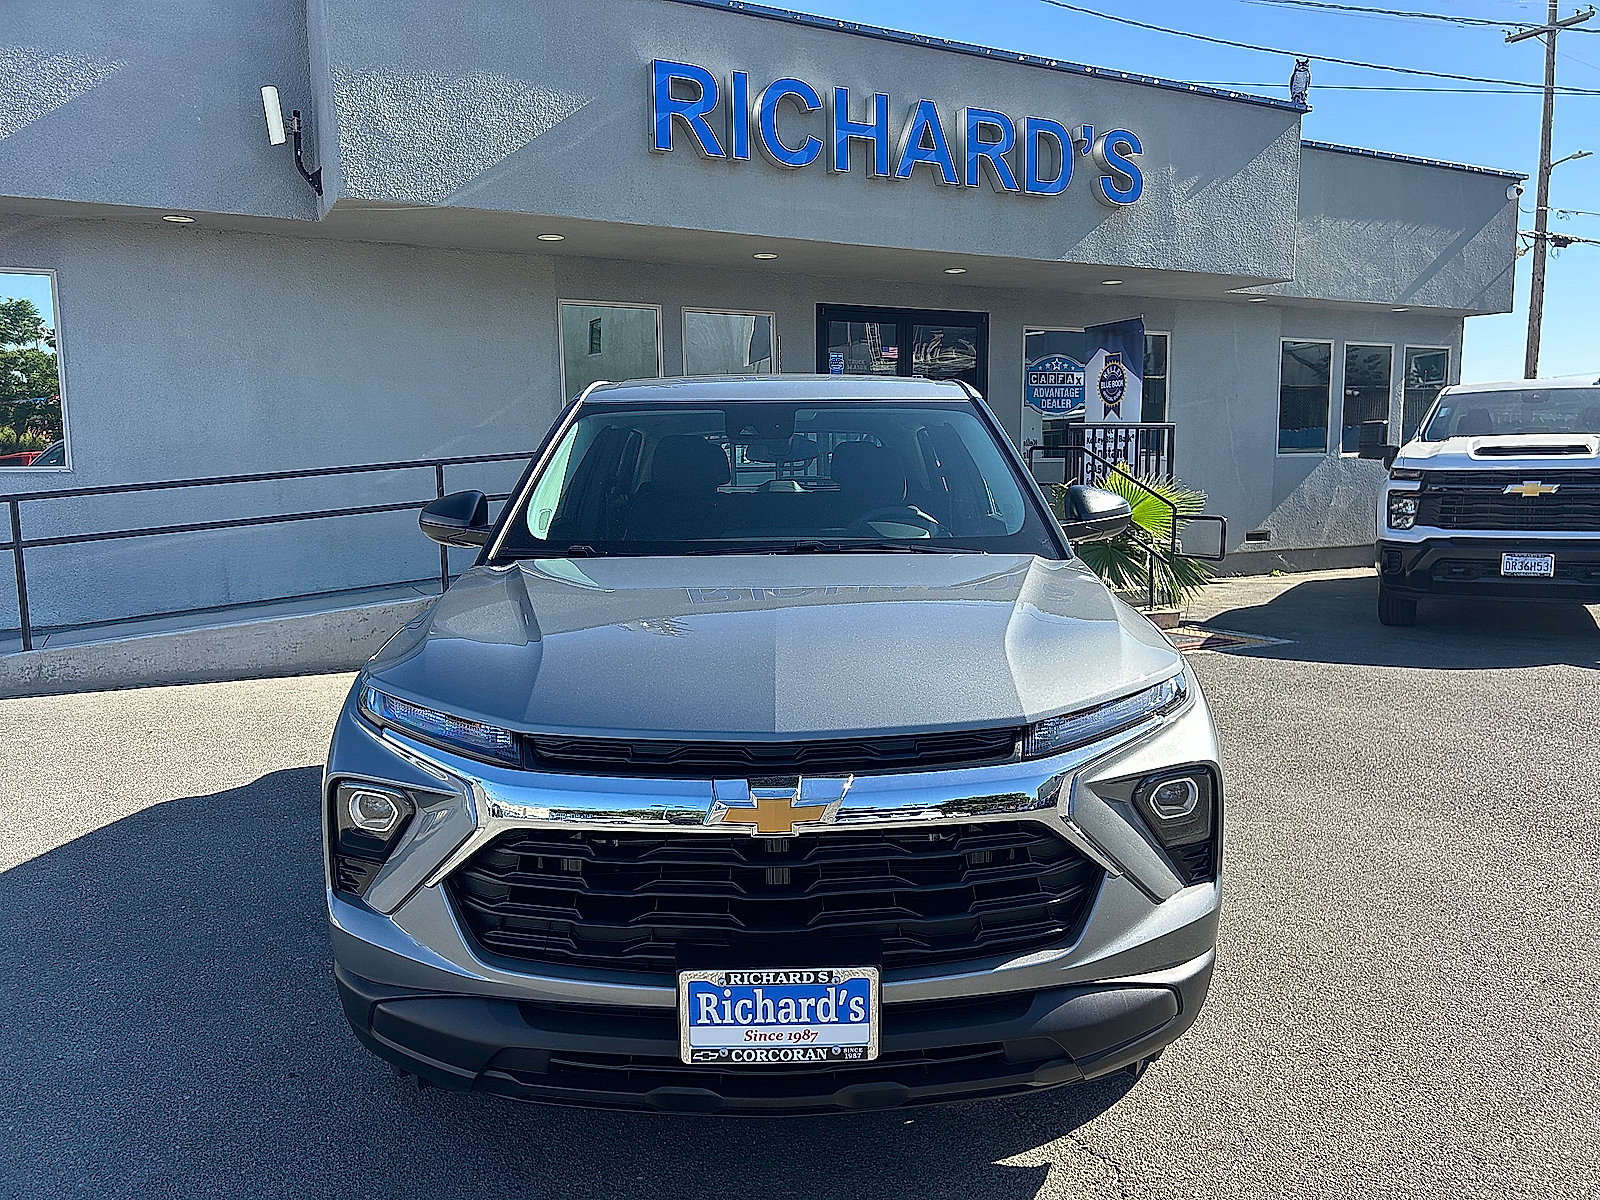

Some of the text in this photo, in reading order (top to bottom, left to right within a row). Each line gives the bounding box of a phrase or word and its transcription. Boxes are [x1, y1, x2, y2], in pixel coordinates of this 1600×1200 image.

[649, 58, 1144, 207] RICHARD'S
[1029, 372, 1084, 386] CARFAX
[1033, 388, 1080, 398] ADVANTAGE
[1041, 399, 1072, 409] DEALER
[1505, 561, 1549, 571] DR36H53
[696, 987, 865, 1024] Richard's
[744, 1029, 818, 1043] Since 1987
[731, 1048, 828, 1062] CORCORAN
